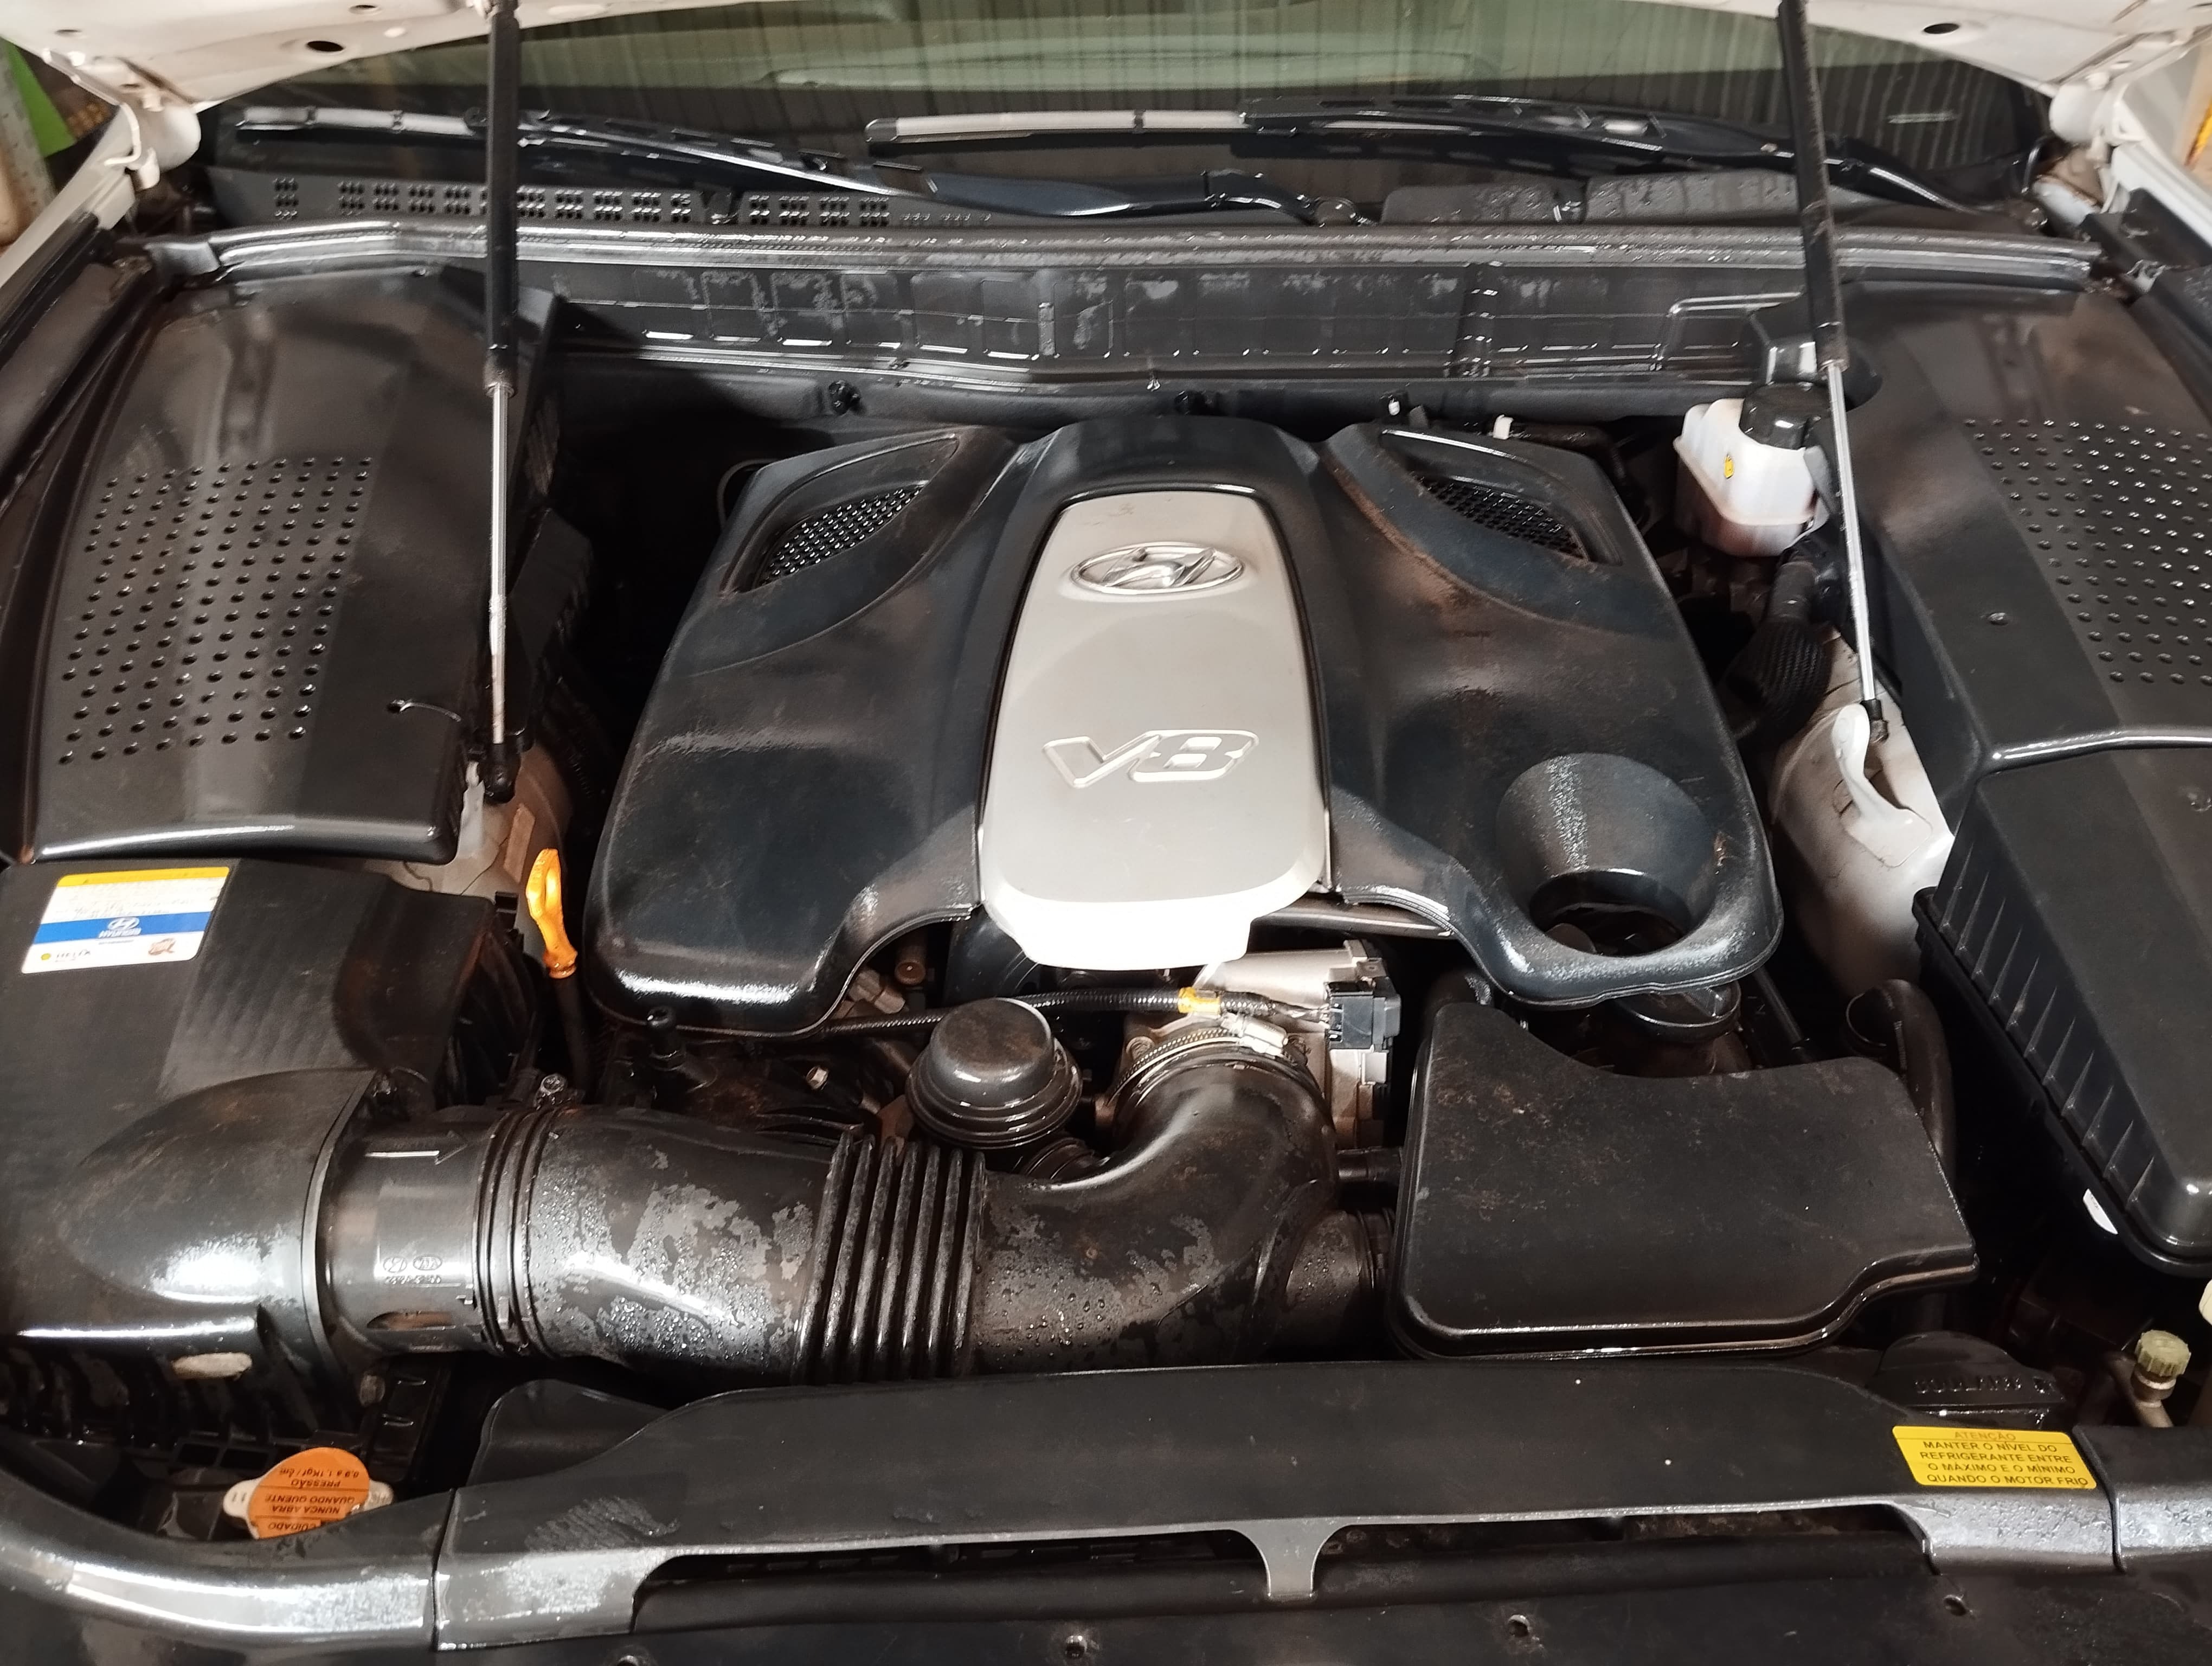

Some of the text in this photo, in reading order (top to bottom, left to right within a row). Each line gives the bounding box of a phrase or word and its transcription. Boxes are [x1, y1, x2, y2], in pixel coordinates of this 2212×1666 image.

[1043, 729, 1259, 789] V8
[1955, 1432, 2016, 1441] ATENÇÃO
[1923, 1441, 1979, 1450] MANTER
[1997, 1441, 2036, 1451] NÍVEL
[1920, 1452, 2072, 1463] REFRIGERANTE ENTRE
[1942, 1462, 1997, 1472] MÁXIMO
[2027, 1464, 2075, 1473] MÍNIMO
[291, 1478, 341, 1489] PRESSÃO
[1927, 1474, 2088, 1486] QUANDO O MOTOR FRIO
[265, 1495, 355, 1504] QUANDO QUENTE
[272, 1505, 340, 1514] NUNCA ABRA
